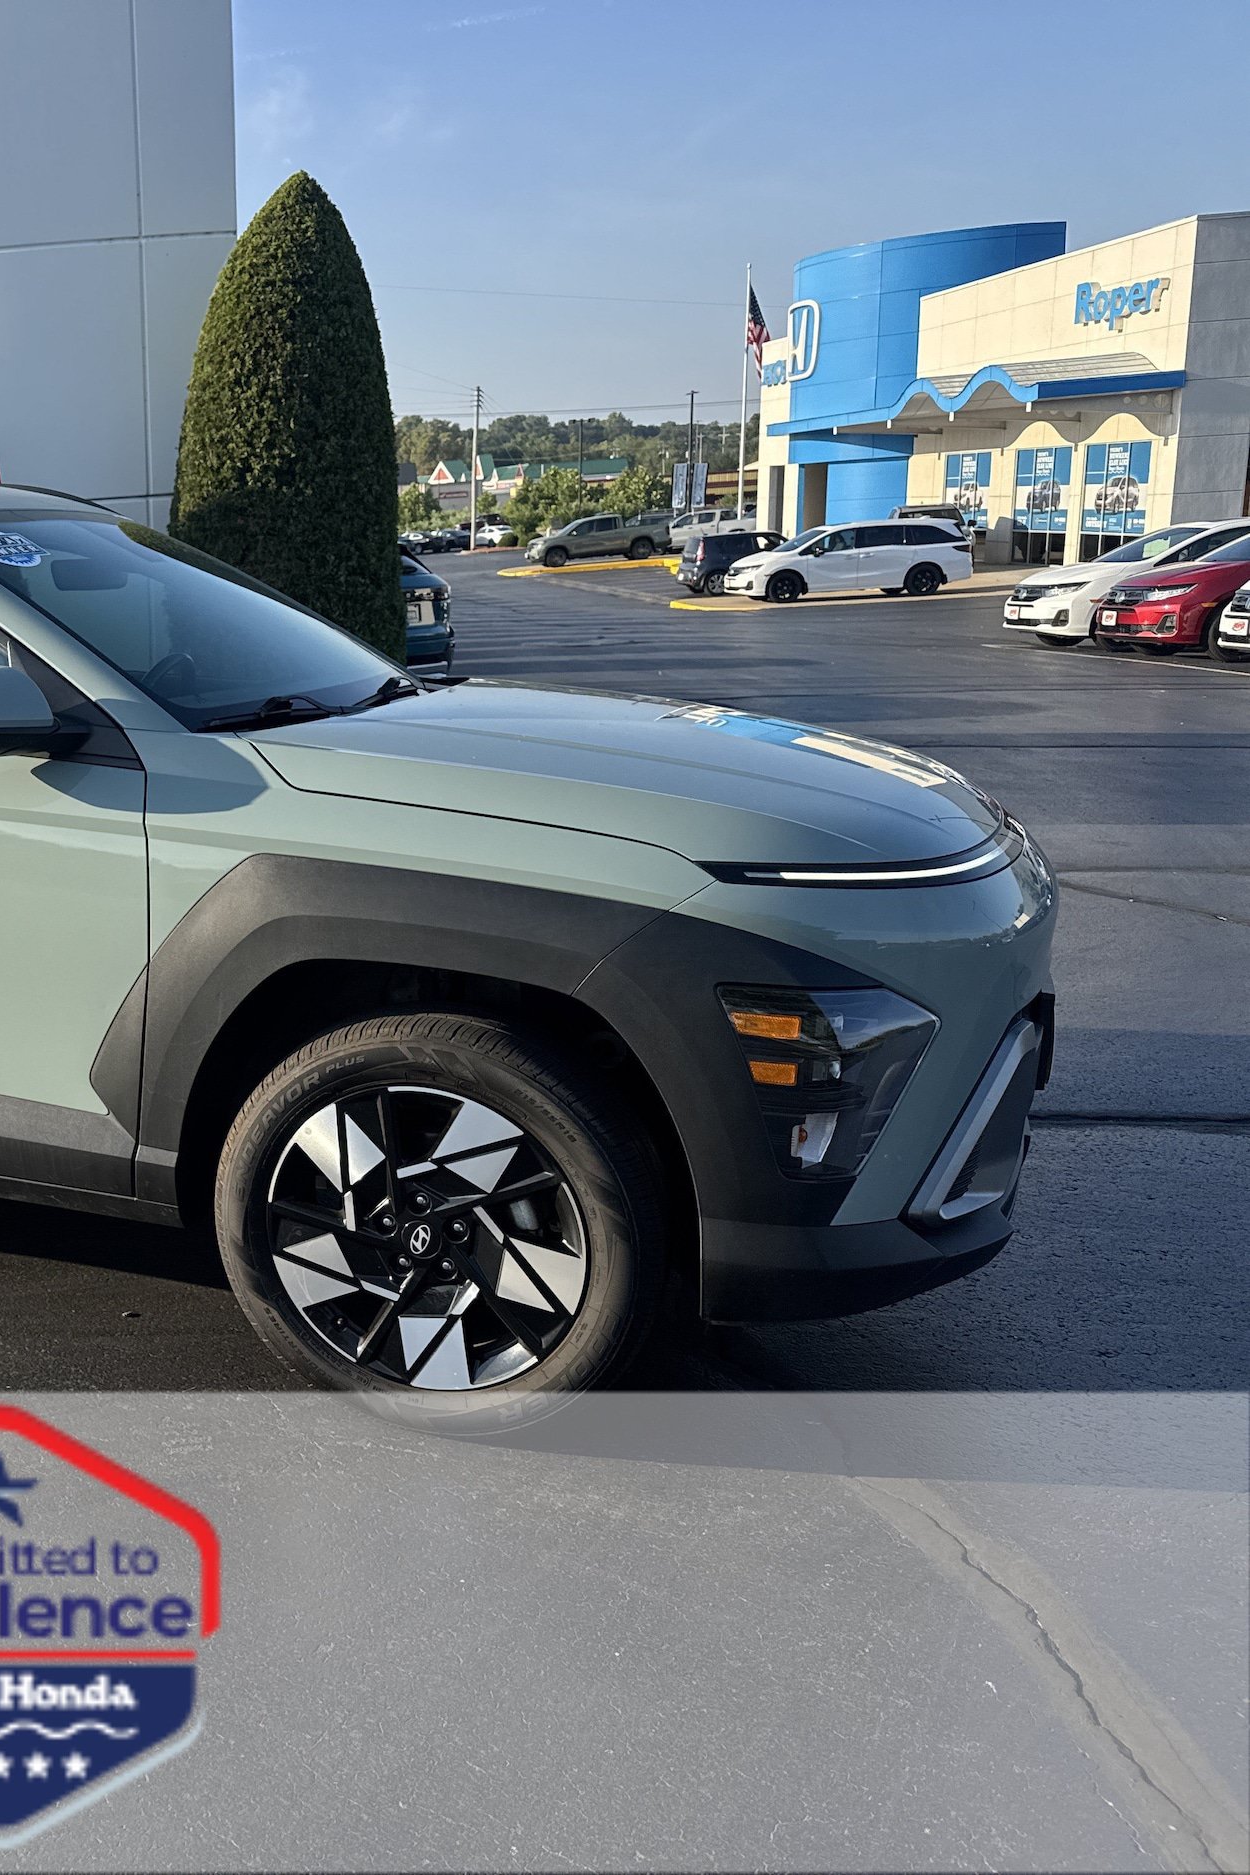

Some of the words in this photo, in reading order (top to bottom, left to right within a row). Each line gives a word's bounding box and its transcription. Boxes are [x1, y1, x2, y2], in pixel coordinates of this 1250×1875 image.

[1074, 278, 1161, 331] Roper
[234, 1071, 321, 1202] ENDEAVOR
[325, 1055, 366, 1074] PLUS
